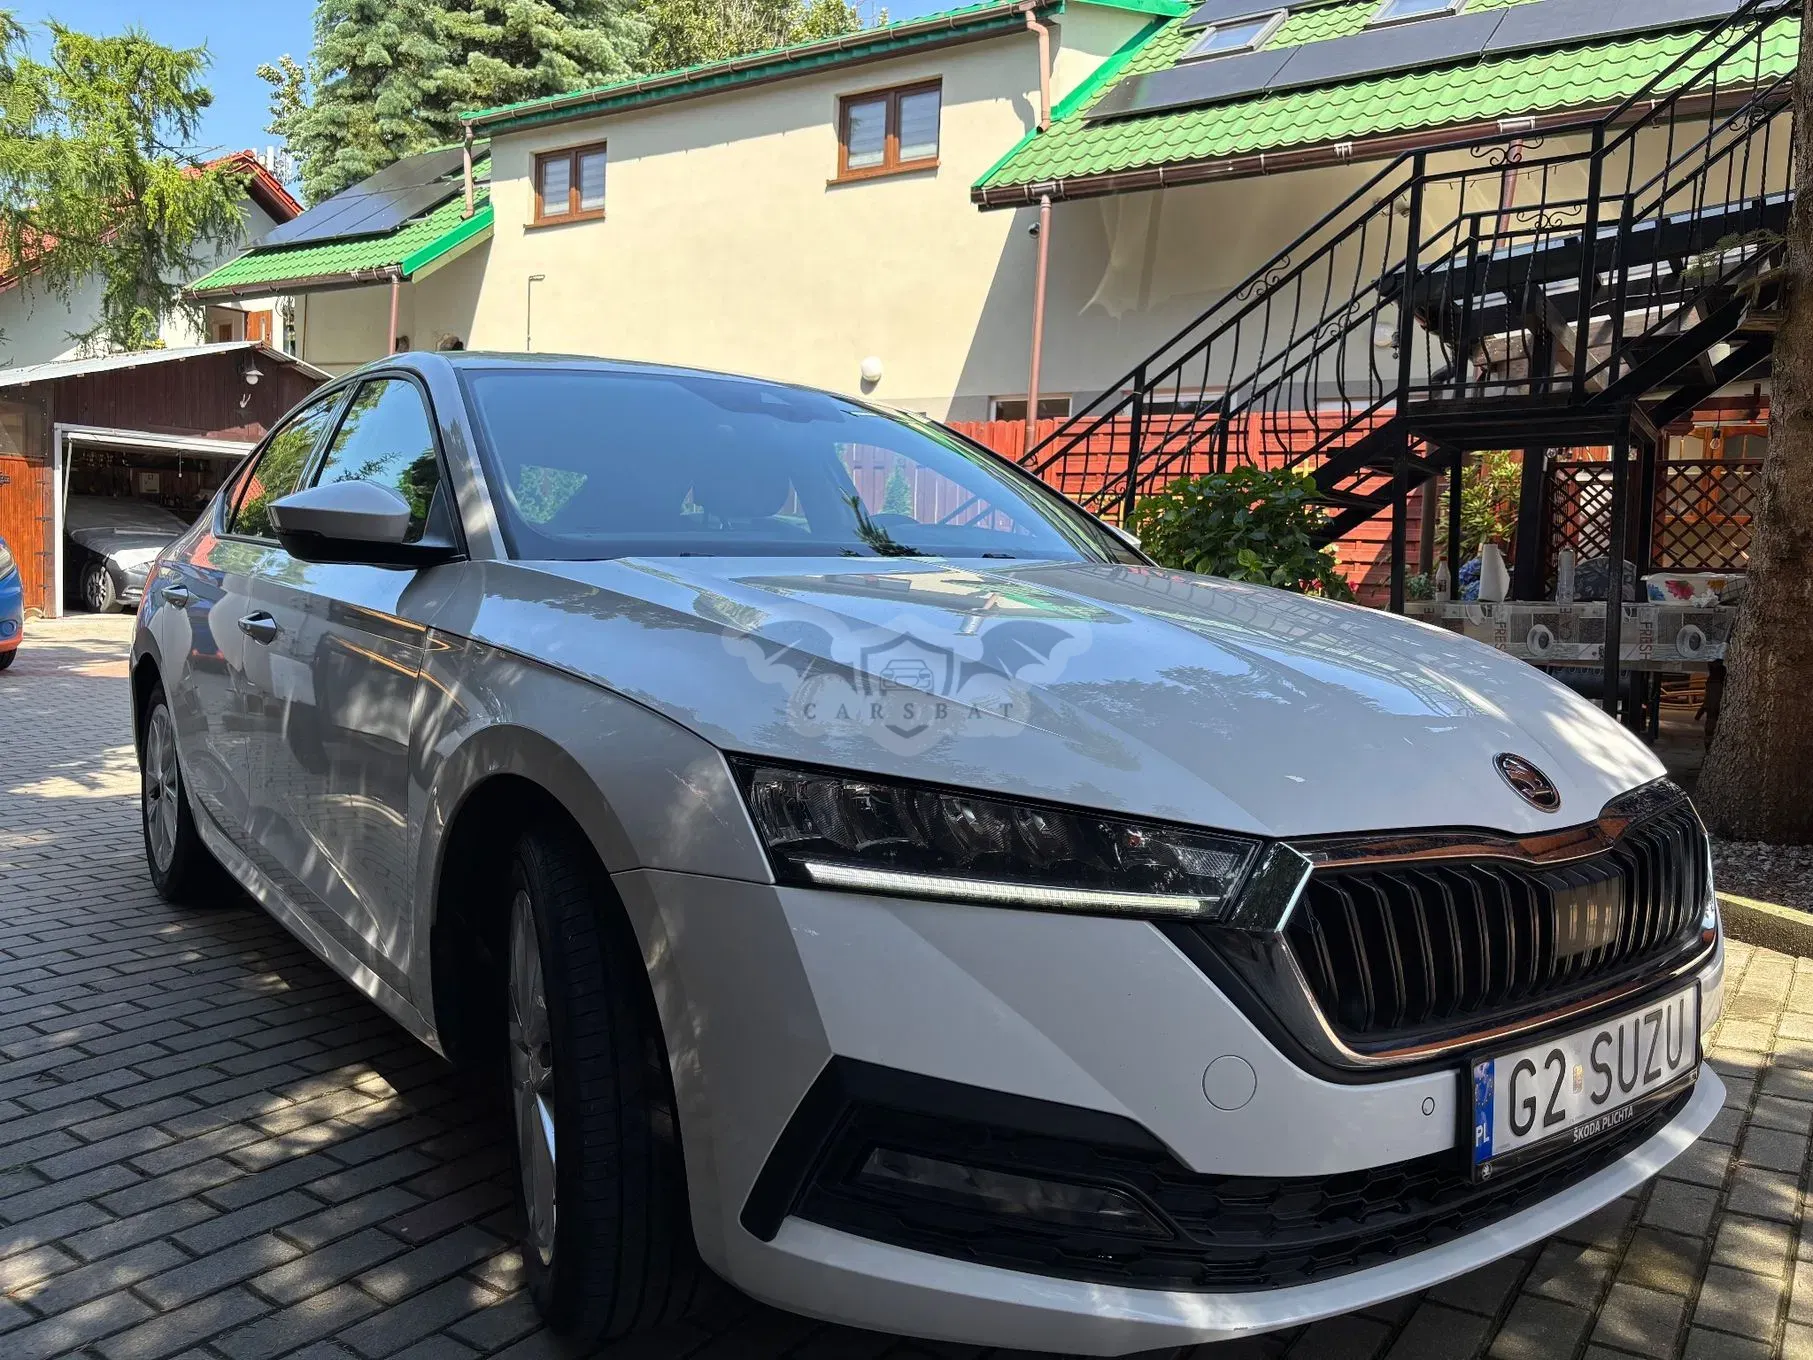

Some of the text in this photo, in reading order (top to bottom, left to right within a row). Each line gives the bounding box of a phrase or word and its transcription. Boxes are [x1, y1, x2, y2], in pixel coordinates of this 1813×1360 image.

[1509, 998, 1684, 1137] G2 SUZU
[1475, 1124, 1490, 1147] PL
[1573, 1105, 1634, 1143] ŠKODA PLICHTA
